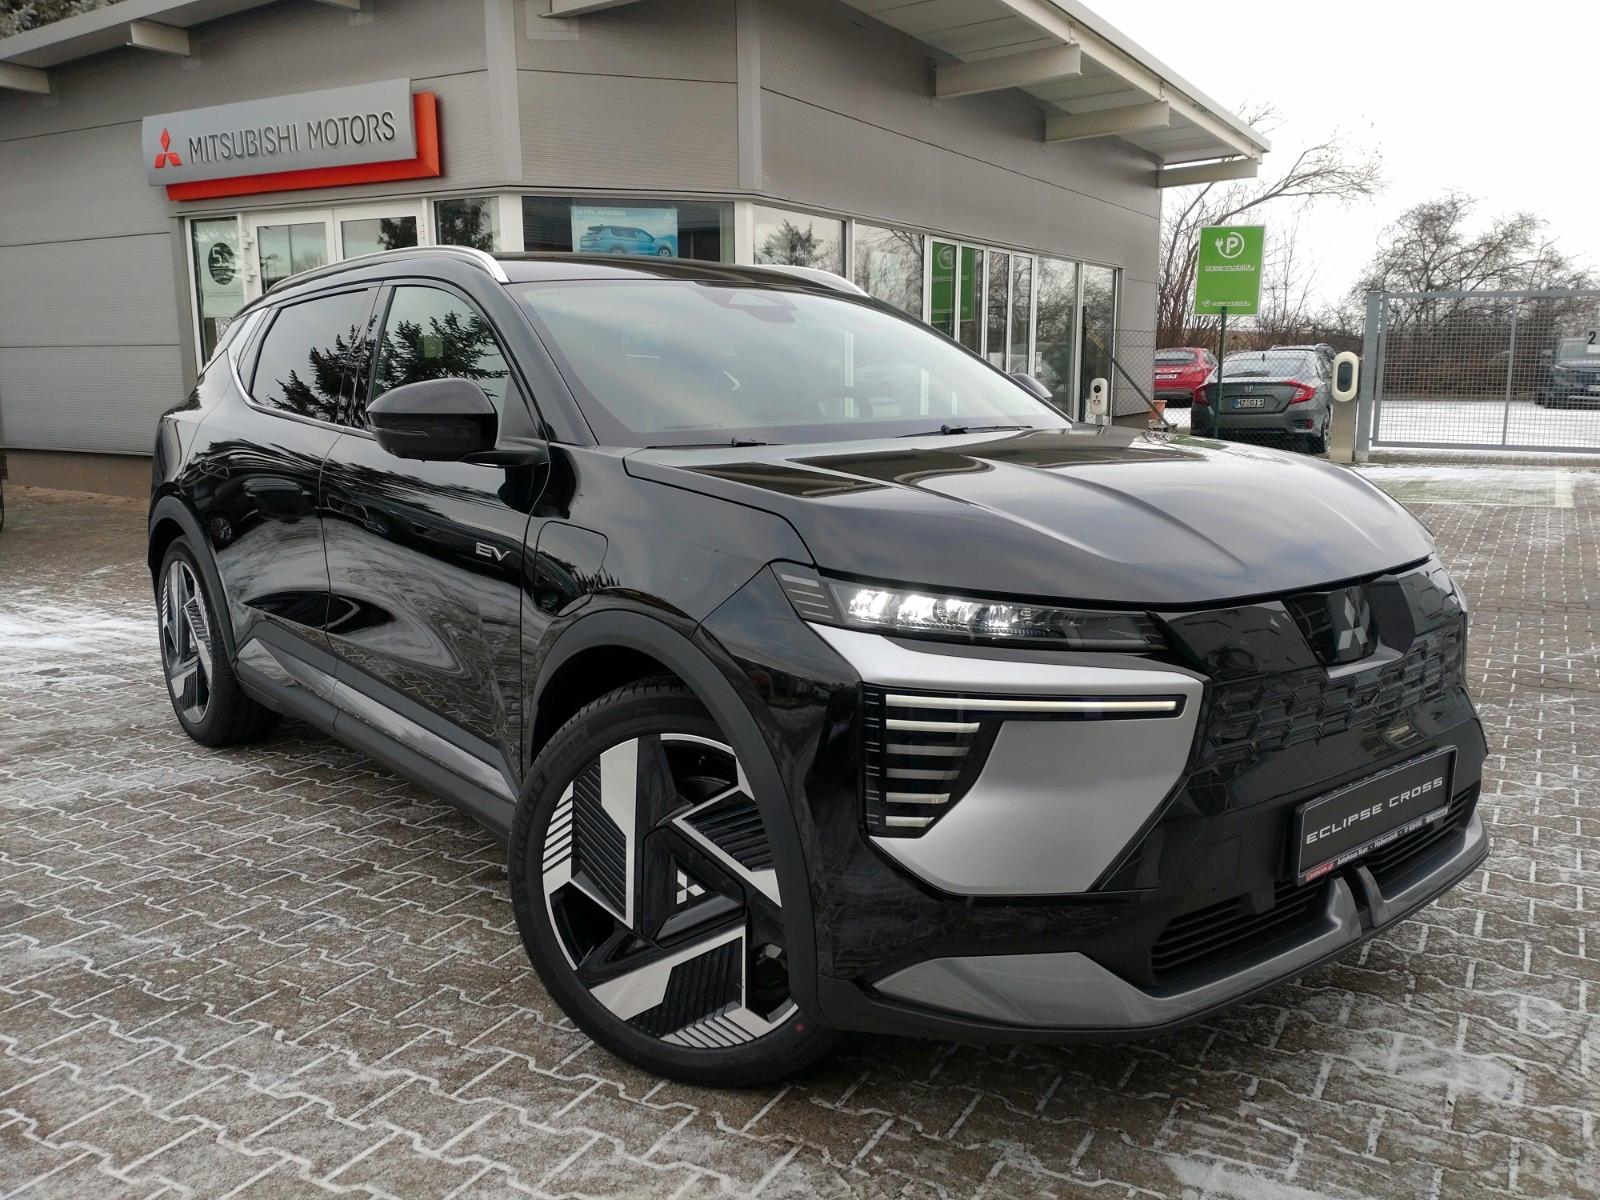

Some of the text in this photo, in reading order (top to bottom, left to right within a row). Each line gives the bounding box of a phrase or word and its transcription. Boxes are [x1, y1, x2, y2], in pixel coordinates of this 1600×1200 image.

[189, 111, 395, 163] MITSUBISHI MOTORS
[1226, 237, 1238, 254] P
[1587, 331, 1597, 345] 2
[475, 542, 511, 561] EV
[1306, 803, 1383, 844] ECLIPSE
[1389, 776, 1443, 808] CROSS
